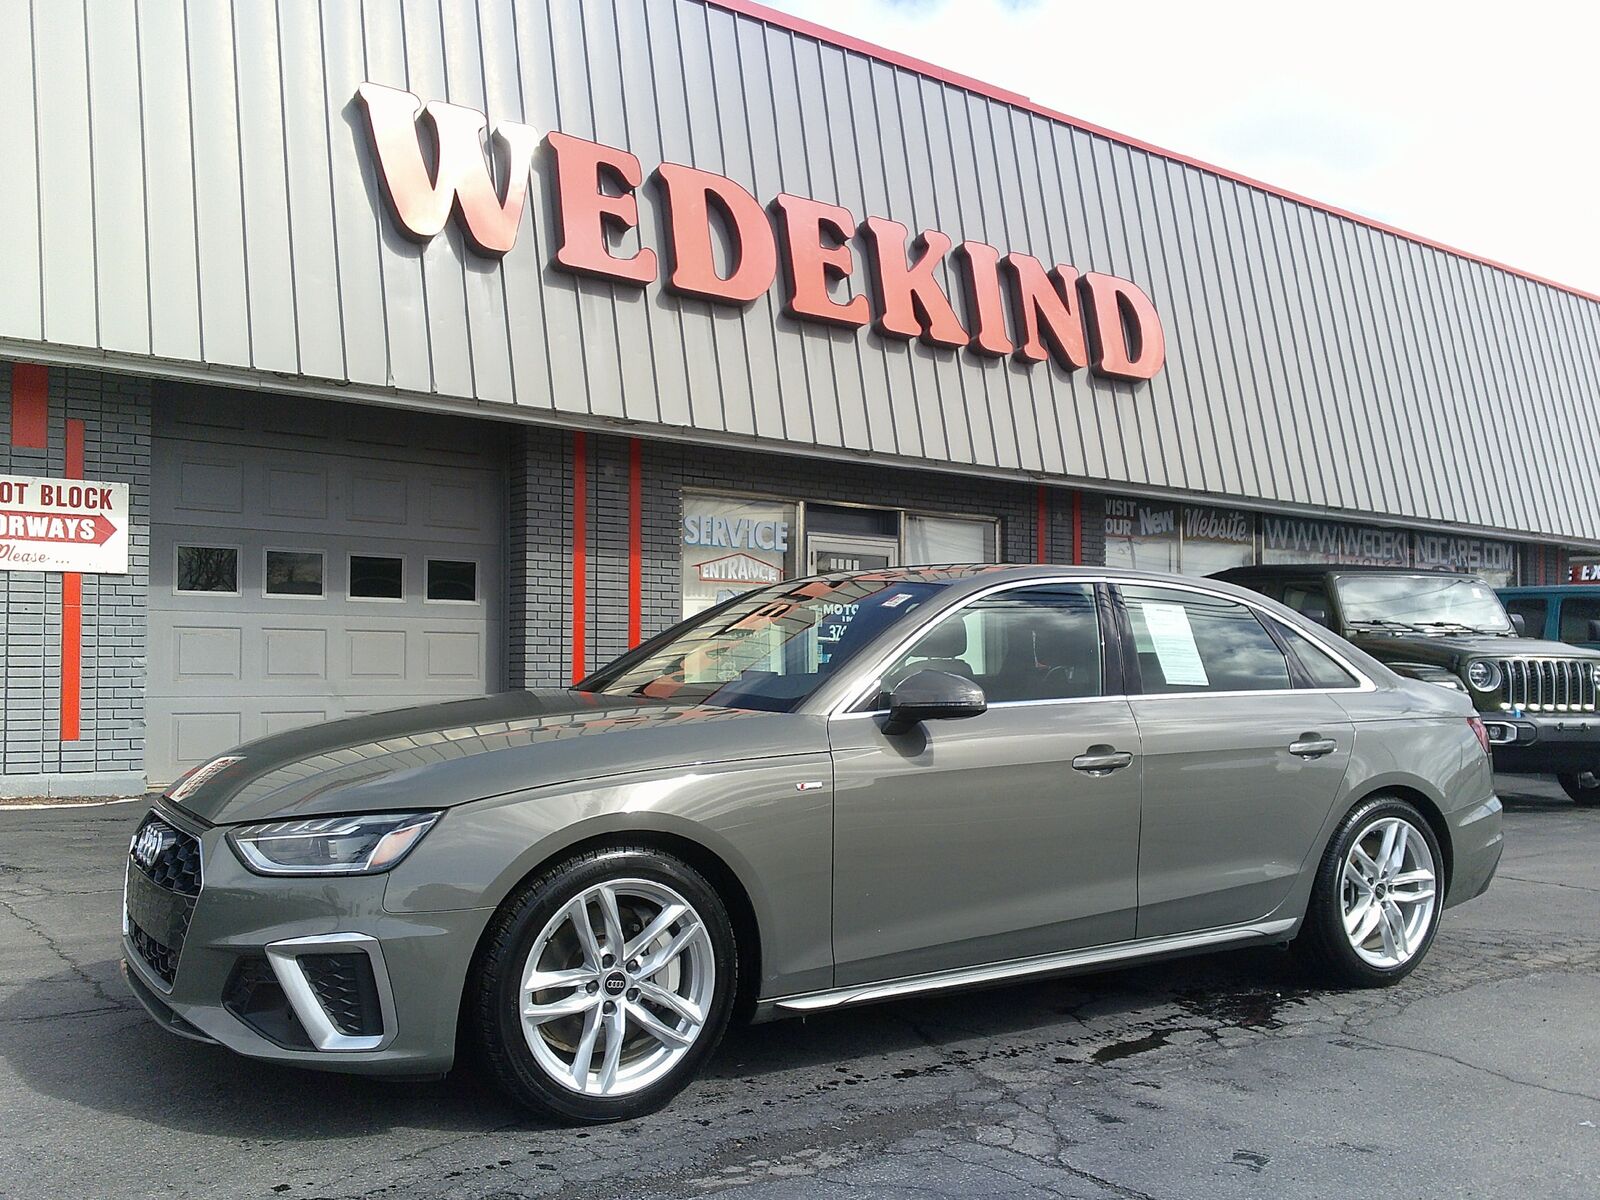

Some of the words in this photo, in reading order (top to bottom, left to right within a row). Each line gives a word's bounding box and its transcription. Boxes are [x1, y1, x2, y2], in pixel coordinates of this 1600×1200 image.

[356, 82, 1166, 381] WEDEKIND
[40, 484, 113, 510] BLOCK
[1105, 499, 1137, 517] VISIT
[1138, 506, 1175, 536] New
[1105, 518, 1132, 535] OUR
[683, 515, 789, 552] SERVICE
[702, 556, 778, 582] ENTRANCE
